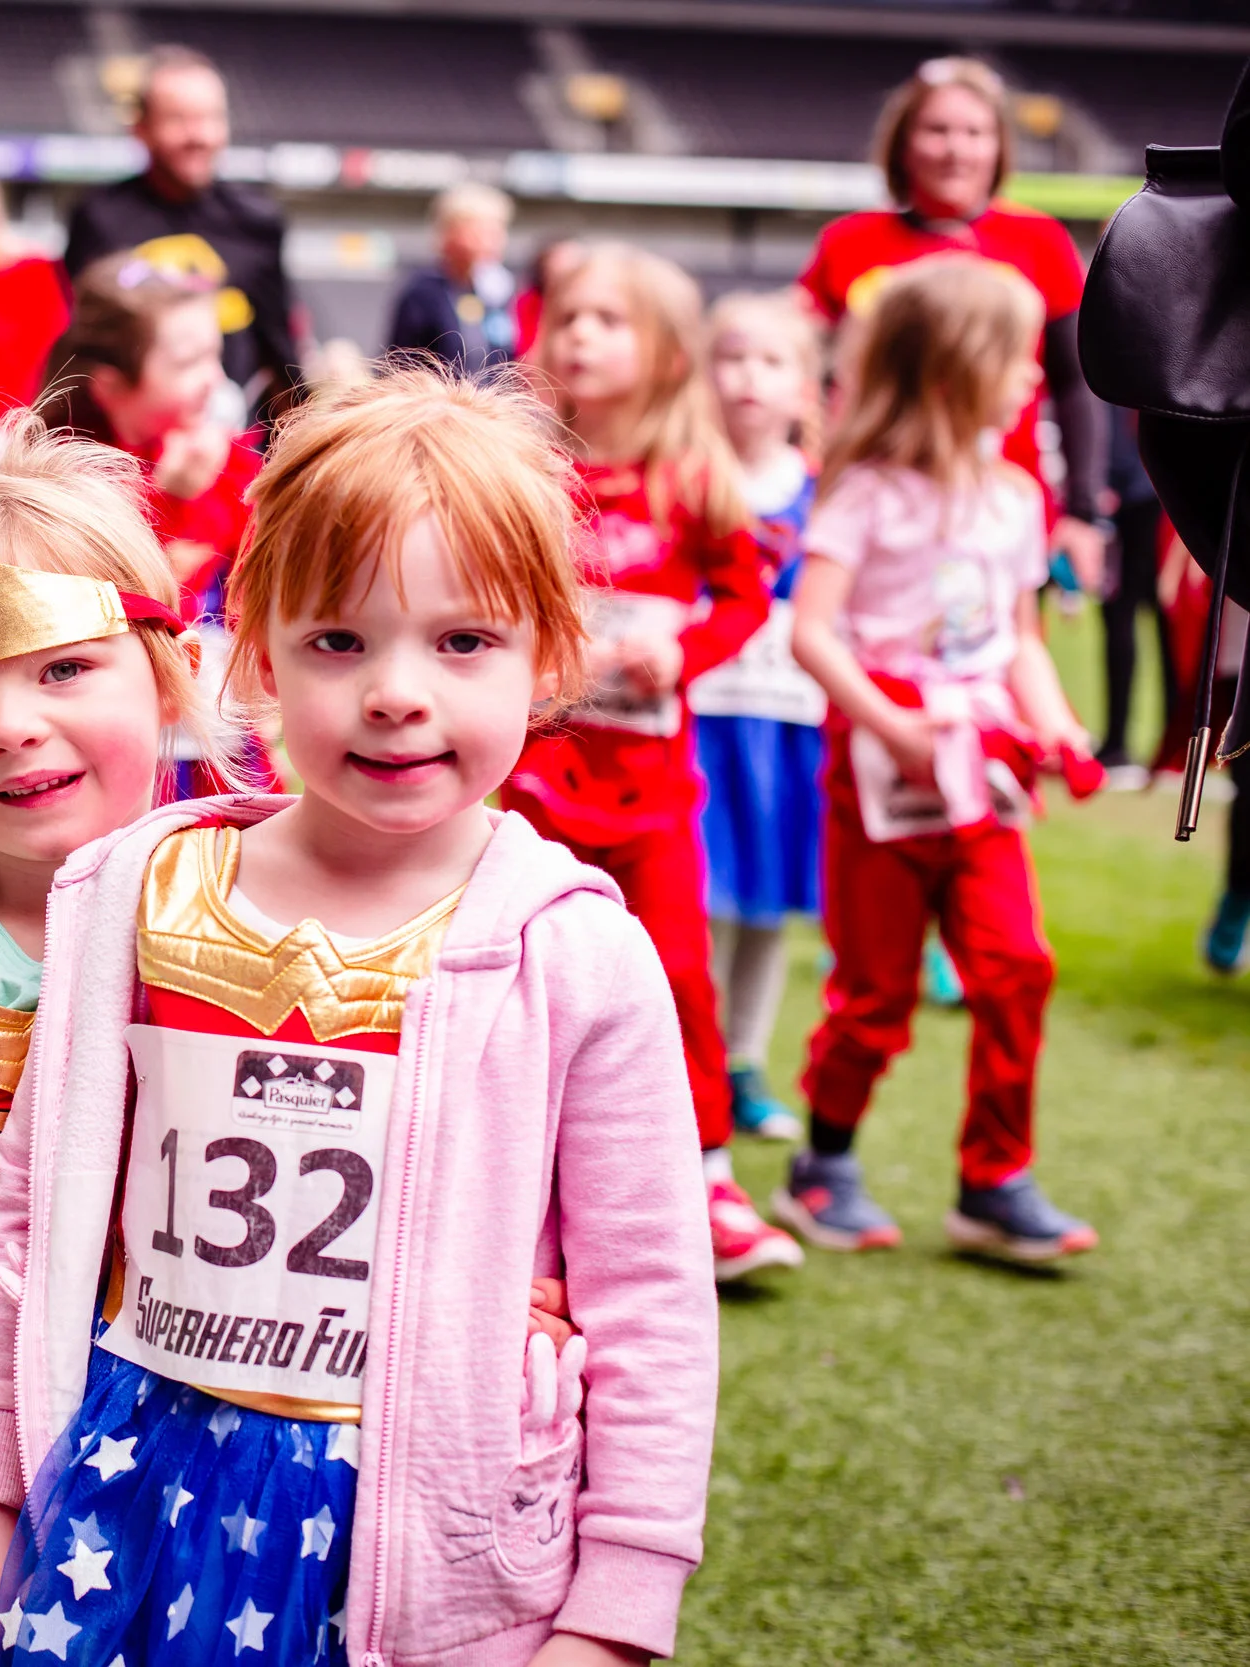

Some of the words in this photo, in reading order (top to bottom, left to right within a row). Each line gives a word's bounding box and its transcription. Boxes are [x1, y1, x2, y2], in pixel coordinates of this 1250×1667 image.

[268, 1087, 327, 1108] Pasquier
[152, 1128, 374, 1281] 132
[135, 1276, 305, 1368] SUPERHERO
